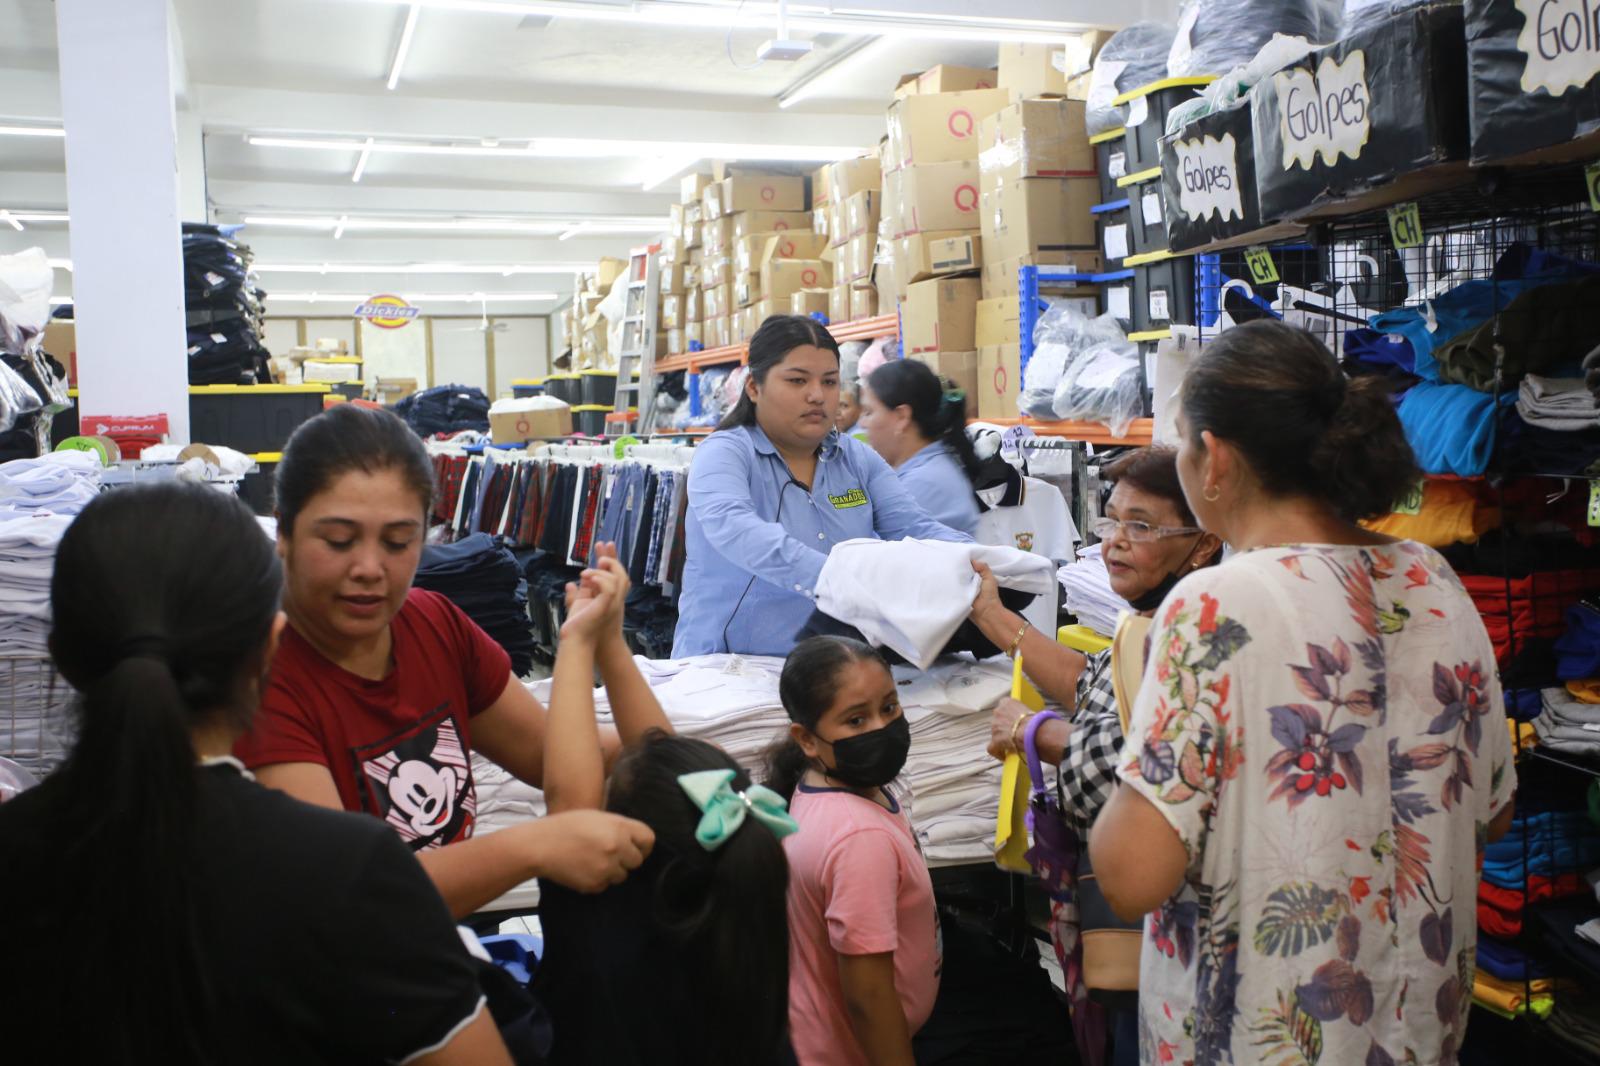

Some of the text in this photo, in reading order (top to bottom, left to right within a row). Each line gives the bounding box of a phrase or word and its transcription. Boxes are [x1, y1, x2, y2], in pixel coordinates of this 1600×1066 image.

[1537, 0, 1600, 59] Gol
[1287, 78, 1365, 140] Golpes
[1184, 155, 1231, 194] Golpes
[1394, 215, 1418, 245] CH
[1251, 256, 1273, 281] CH
[1012, 426, 1023, 438] 12
